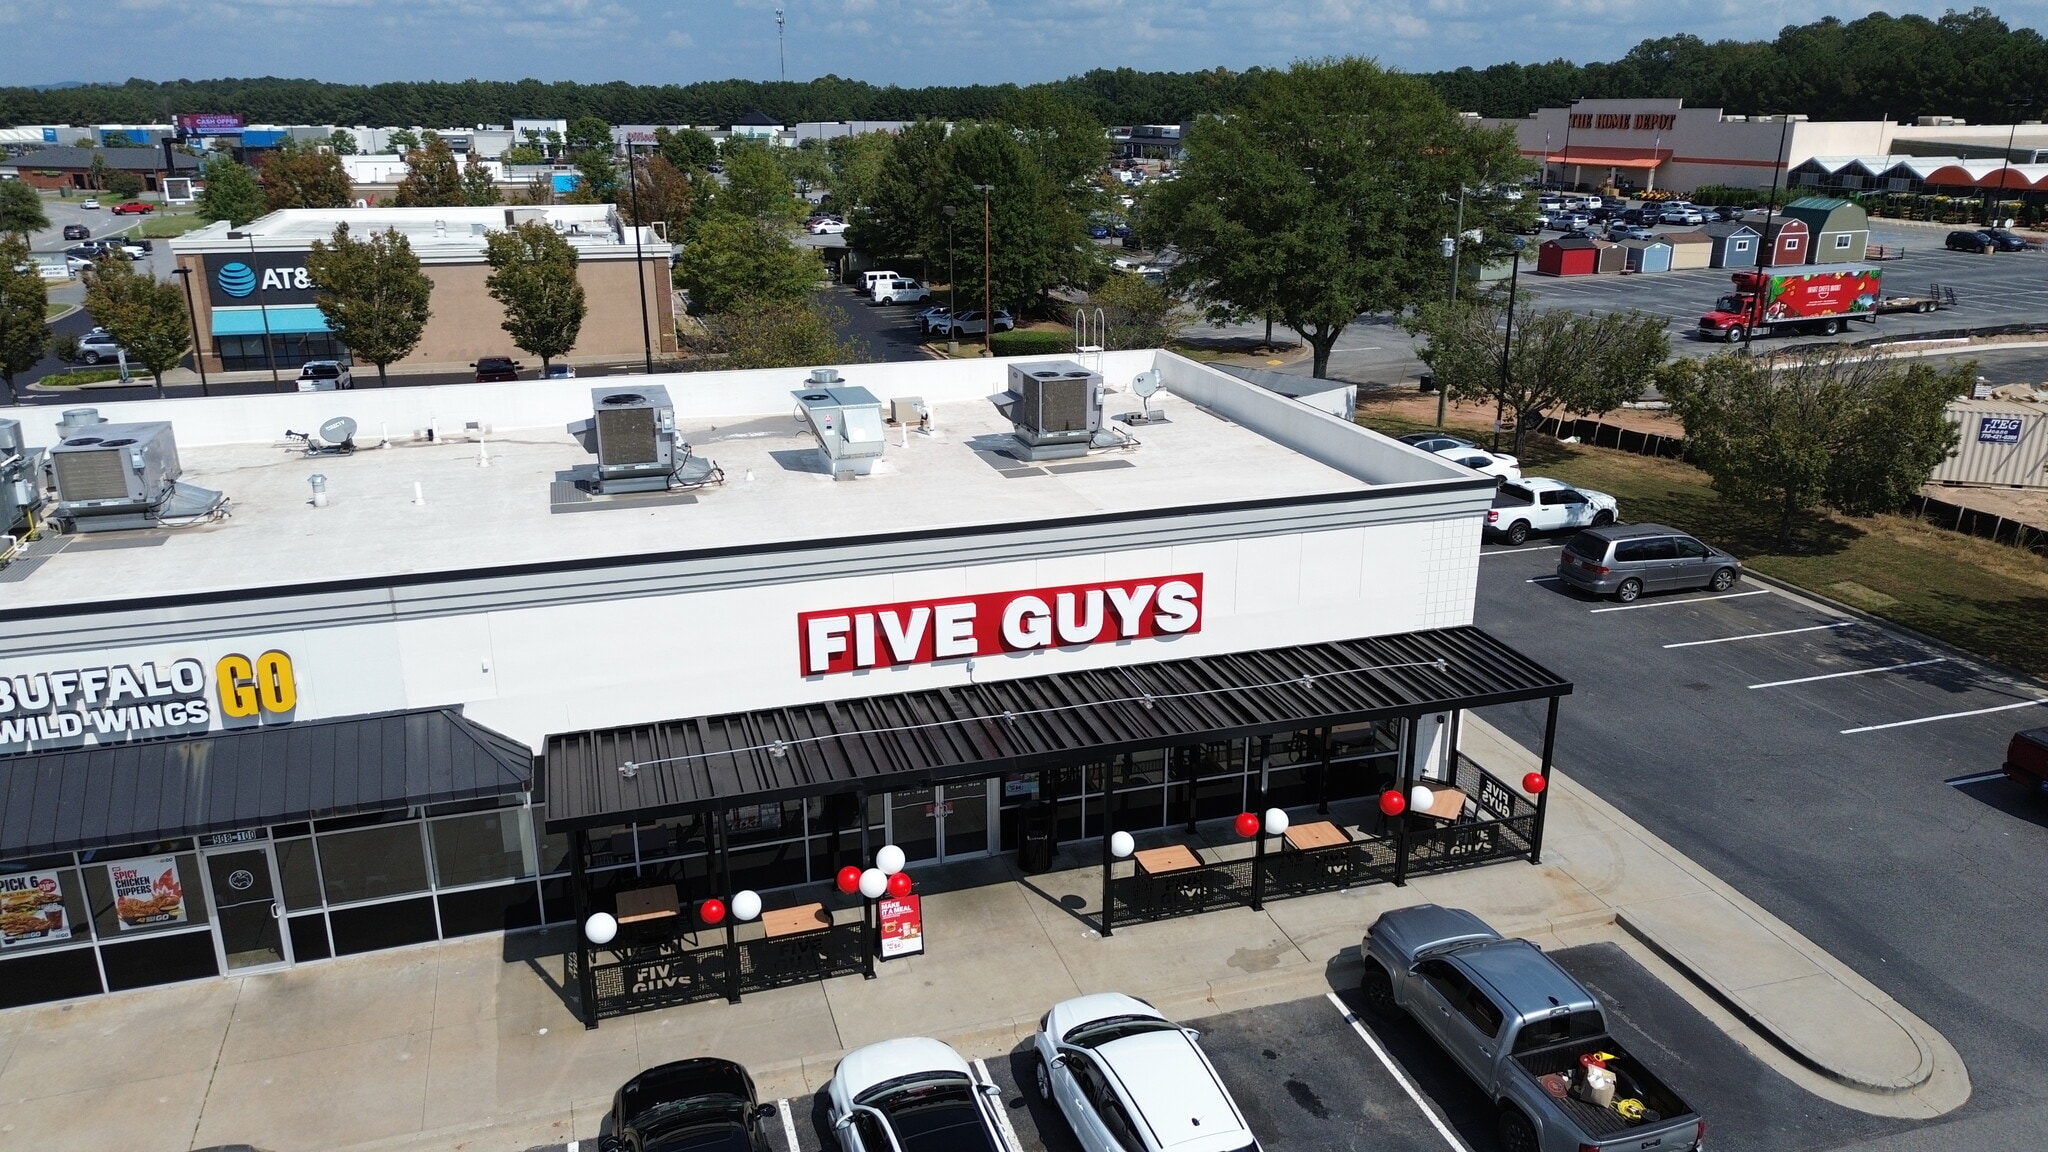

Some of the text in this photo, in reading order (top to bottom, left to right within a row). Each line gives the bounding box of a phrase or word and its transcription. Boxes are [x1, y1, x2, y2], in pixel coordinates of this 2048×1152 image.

[1570, 114, 1676, 130] THE HOME DEPOT
[262, 267, 312, 289] AT&
[1990, 419, 2020, 430] TEG
[807, 581, 1199, 672] FIVE GUYS
[216, 652, 297, 718] GO
[92, 700, 209, 734] WINGS
[212, 830, 256, 844] 908-100
[113, 869, 138, 880] SPICY
[29, 875, 39, 888] 6
[115, 876, 151, 889] CHICKEN
[117, 885, 152, 897] DIPPERS
[881, 901, 901, 910] MAKE
[893, 905, 912, 914] MEAL
